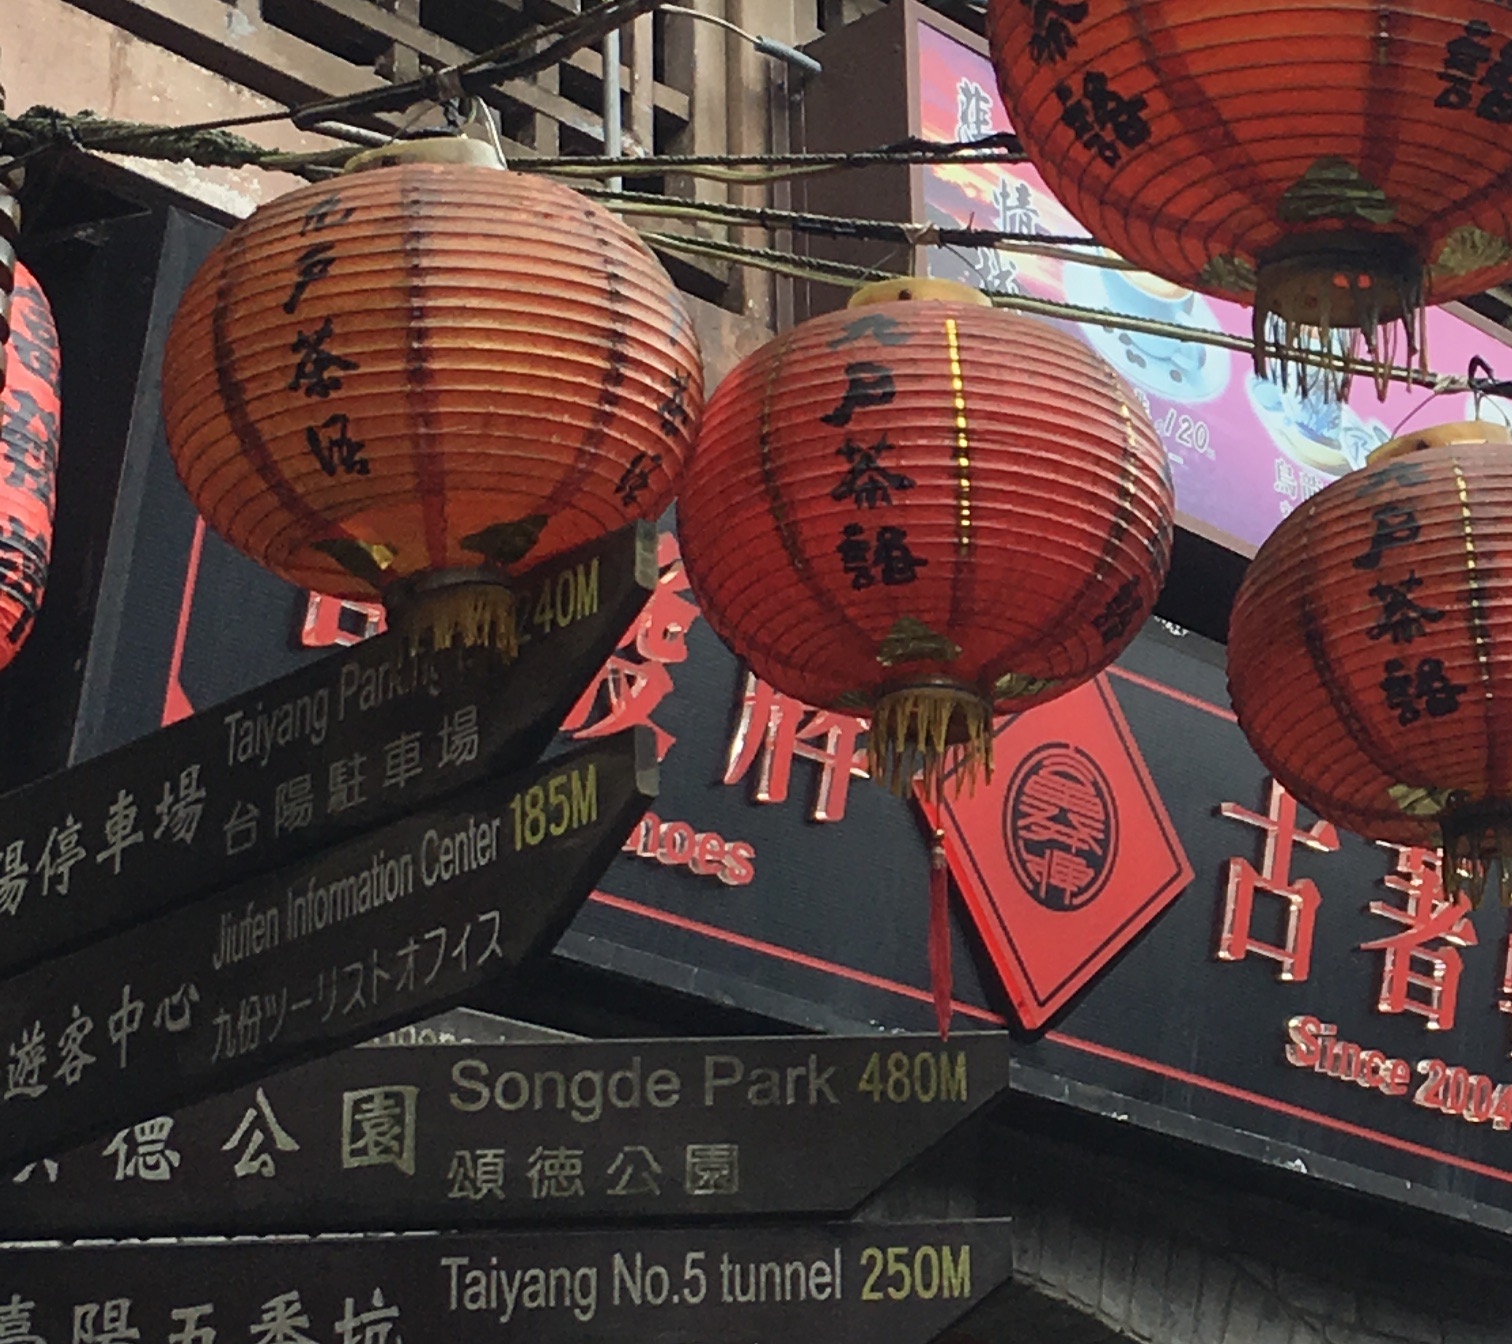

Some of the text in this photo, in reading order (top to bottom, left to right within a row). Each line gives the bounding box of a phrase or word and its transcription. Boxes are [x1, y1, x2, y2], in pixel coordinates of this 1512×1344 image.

[224, 687, 330, 767] Taiyang
[223, 704, 479, 856] 台陽駐車場
[211, 763, 598, 970] Jiufen Information Center 185M
[211, 910, 503, 1064] 九份ツーリストオフィス
[449, 1052, 968, 1123] Songde Park 480M
[1285, 1016, 1411, 1096] Since
[440, 1245, 971, 1322] Taiyang No.5 tunnel 250M
